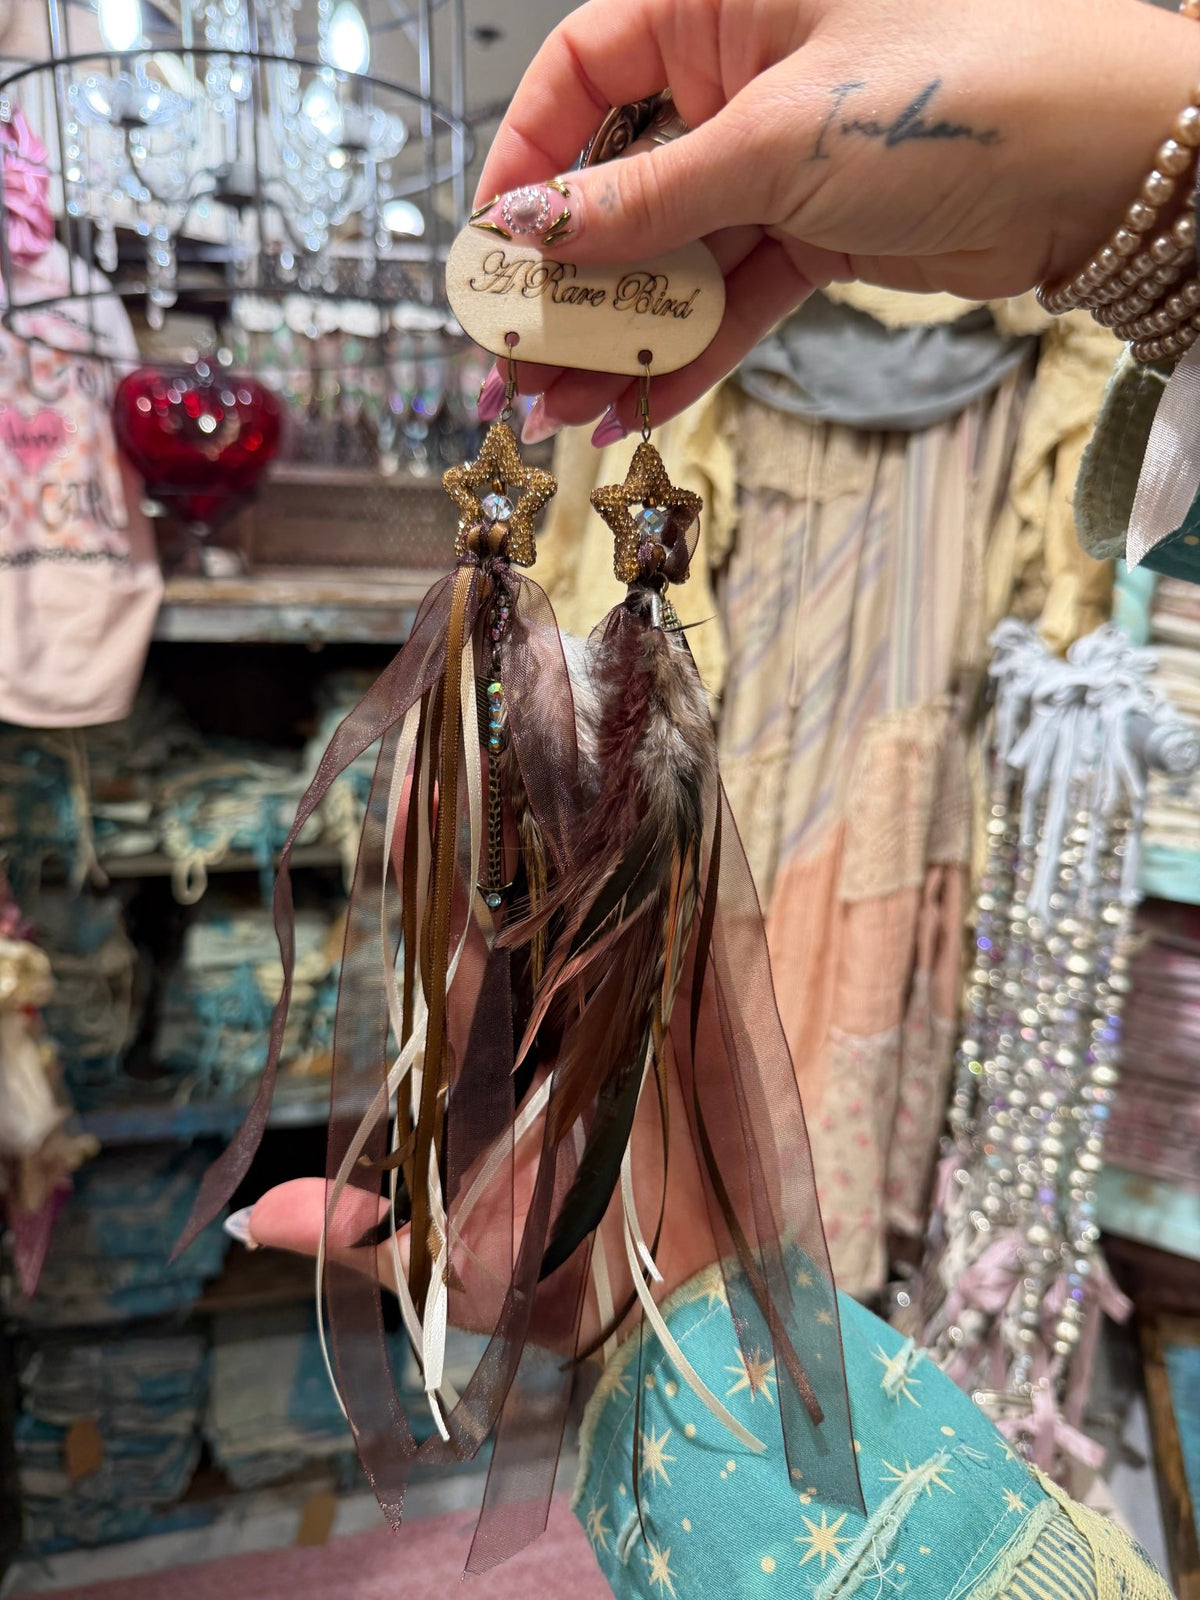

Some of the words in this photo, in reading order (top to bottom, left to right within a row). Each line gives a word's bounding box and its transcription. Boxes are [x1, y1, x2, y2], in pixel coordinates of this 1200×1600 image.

[469, 250, 534, 294] A
[521, 259, 606, 307] Rare
[613, 271, 700, 319] Bird
